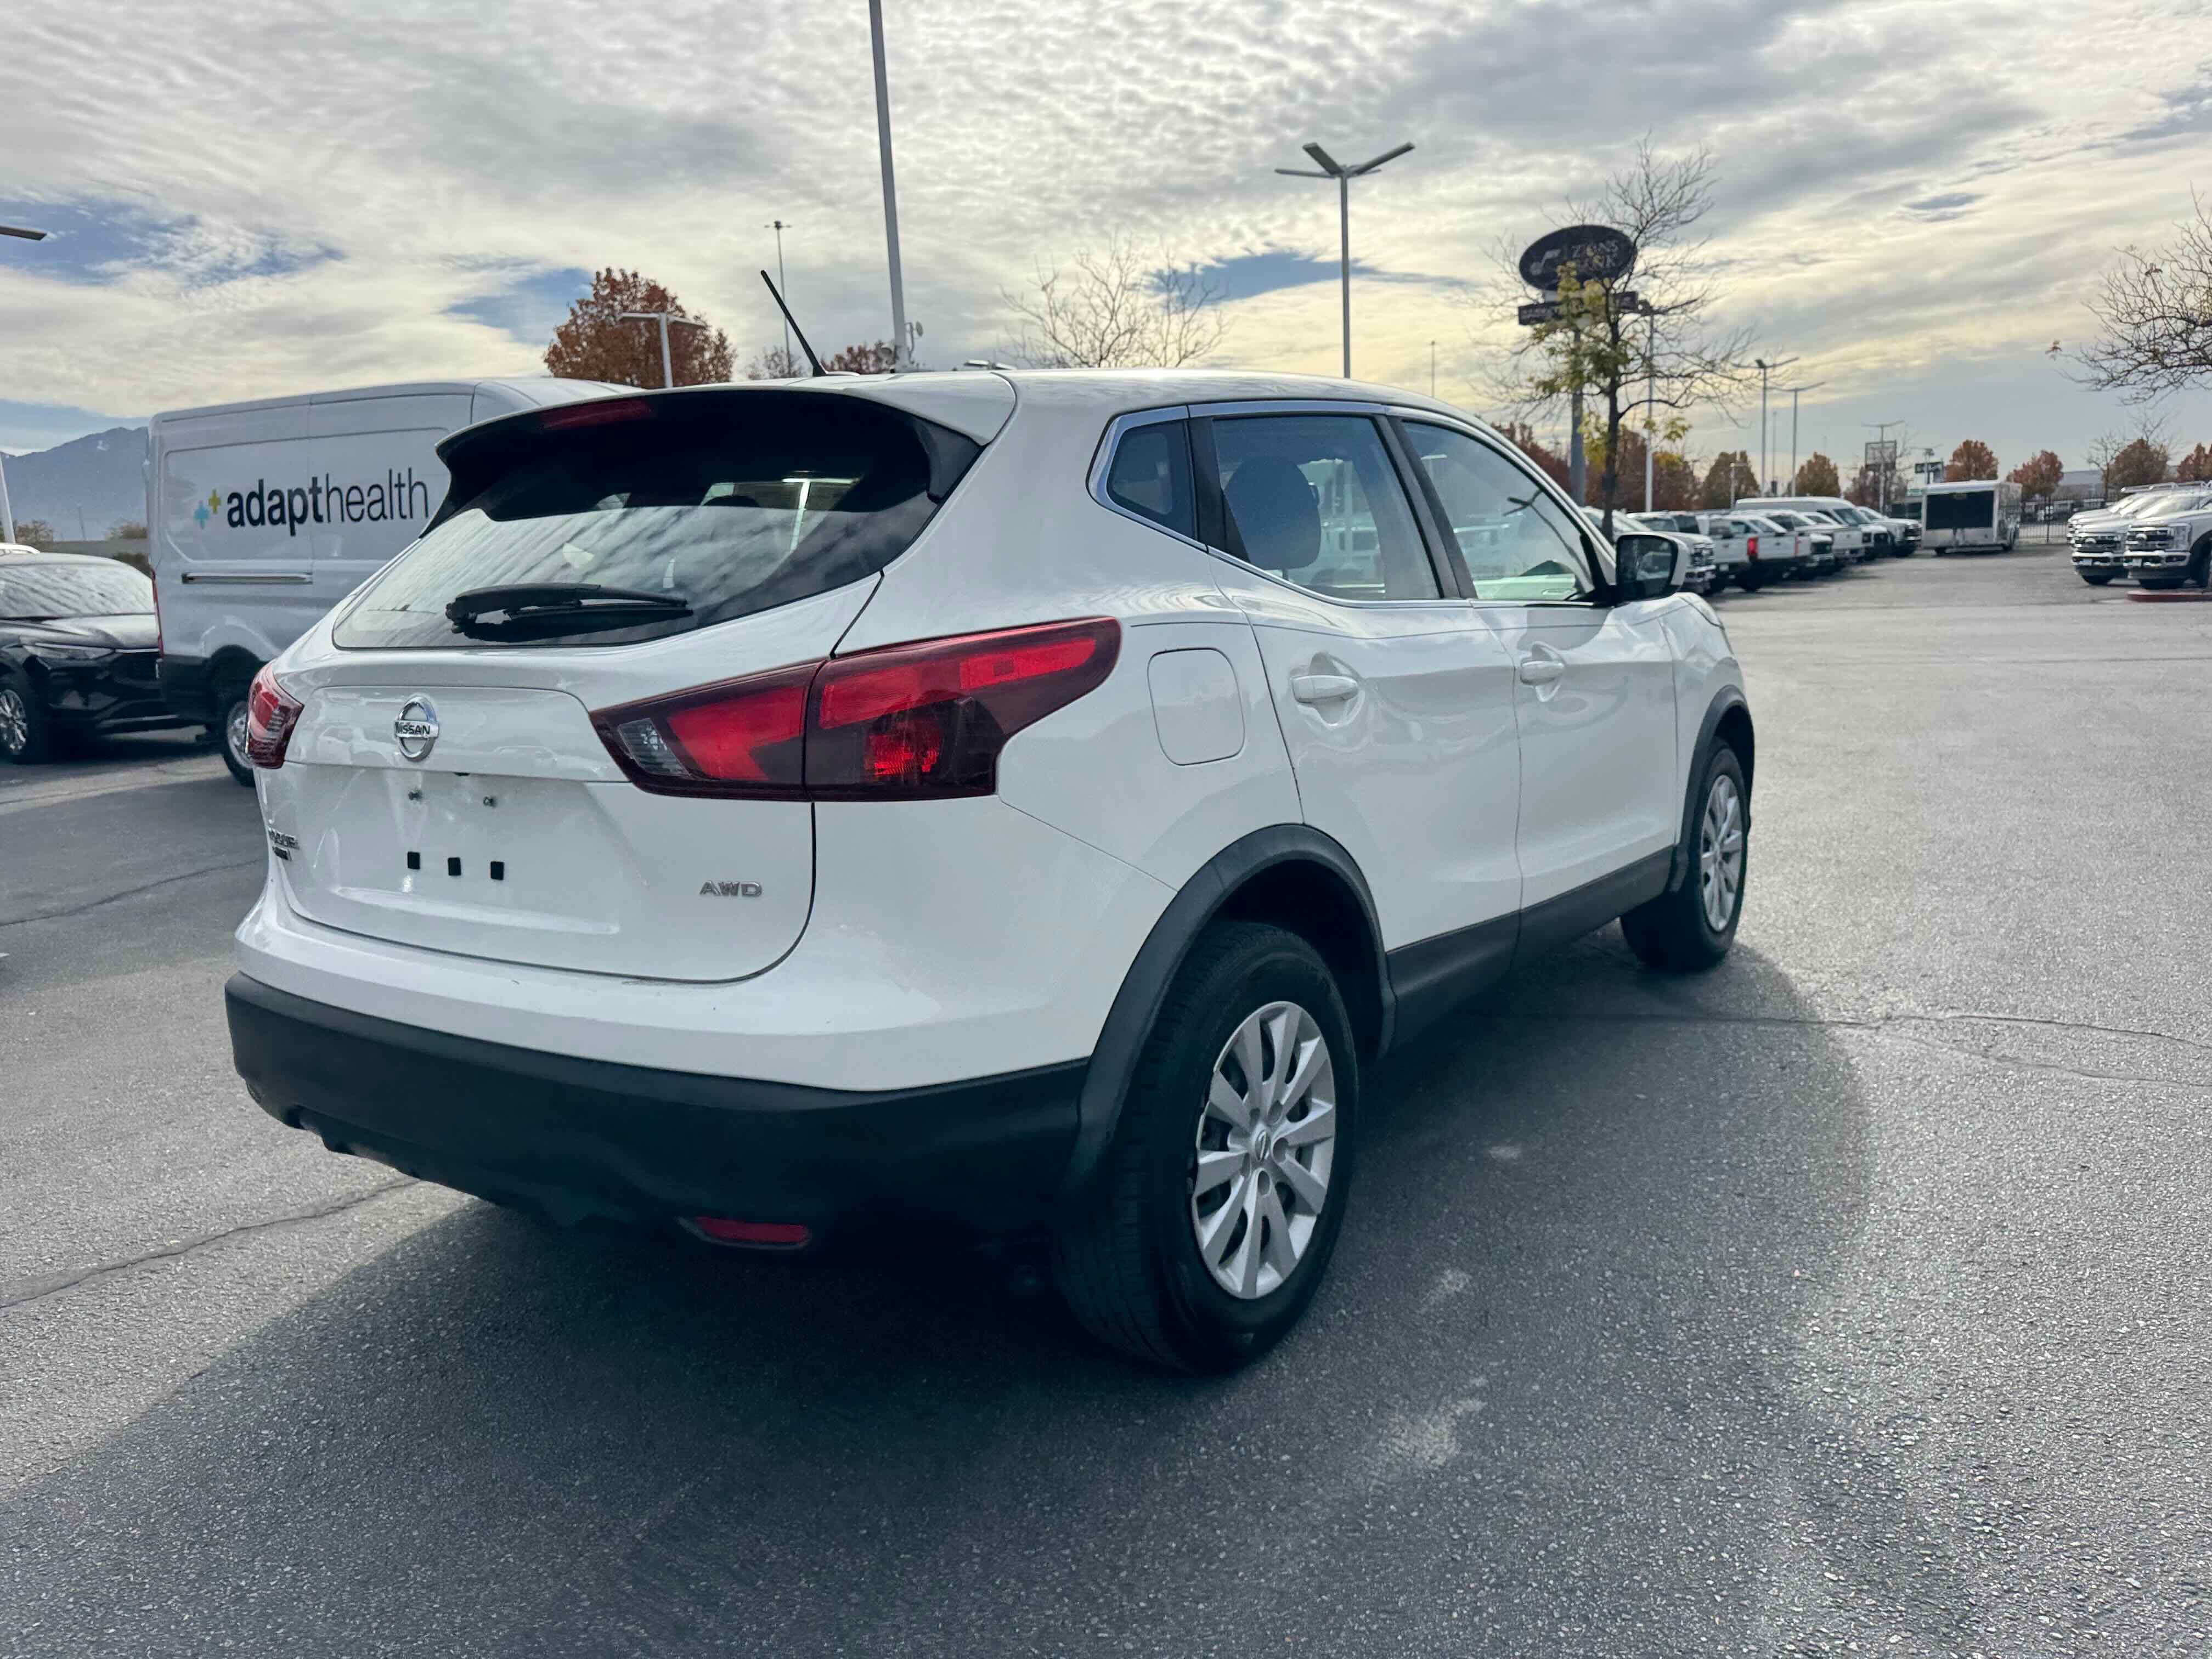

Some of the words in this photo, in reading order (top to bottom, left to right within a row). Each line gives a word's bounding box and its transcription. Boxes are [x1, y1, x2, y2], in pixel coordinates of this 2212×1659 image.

[227, 467, 429, 536] adapthealth
[395, 721, 431, 735] NISSAN
[699, 881, 762, 896] AWD
